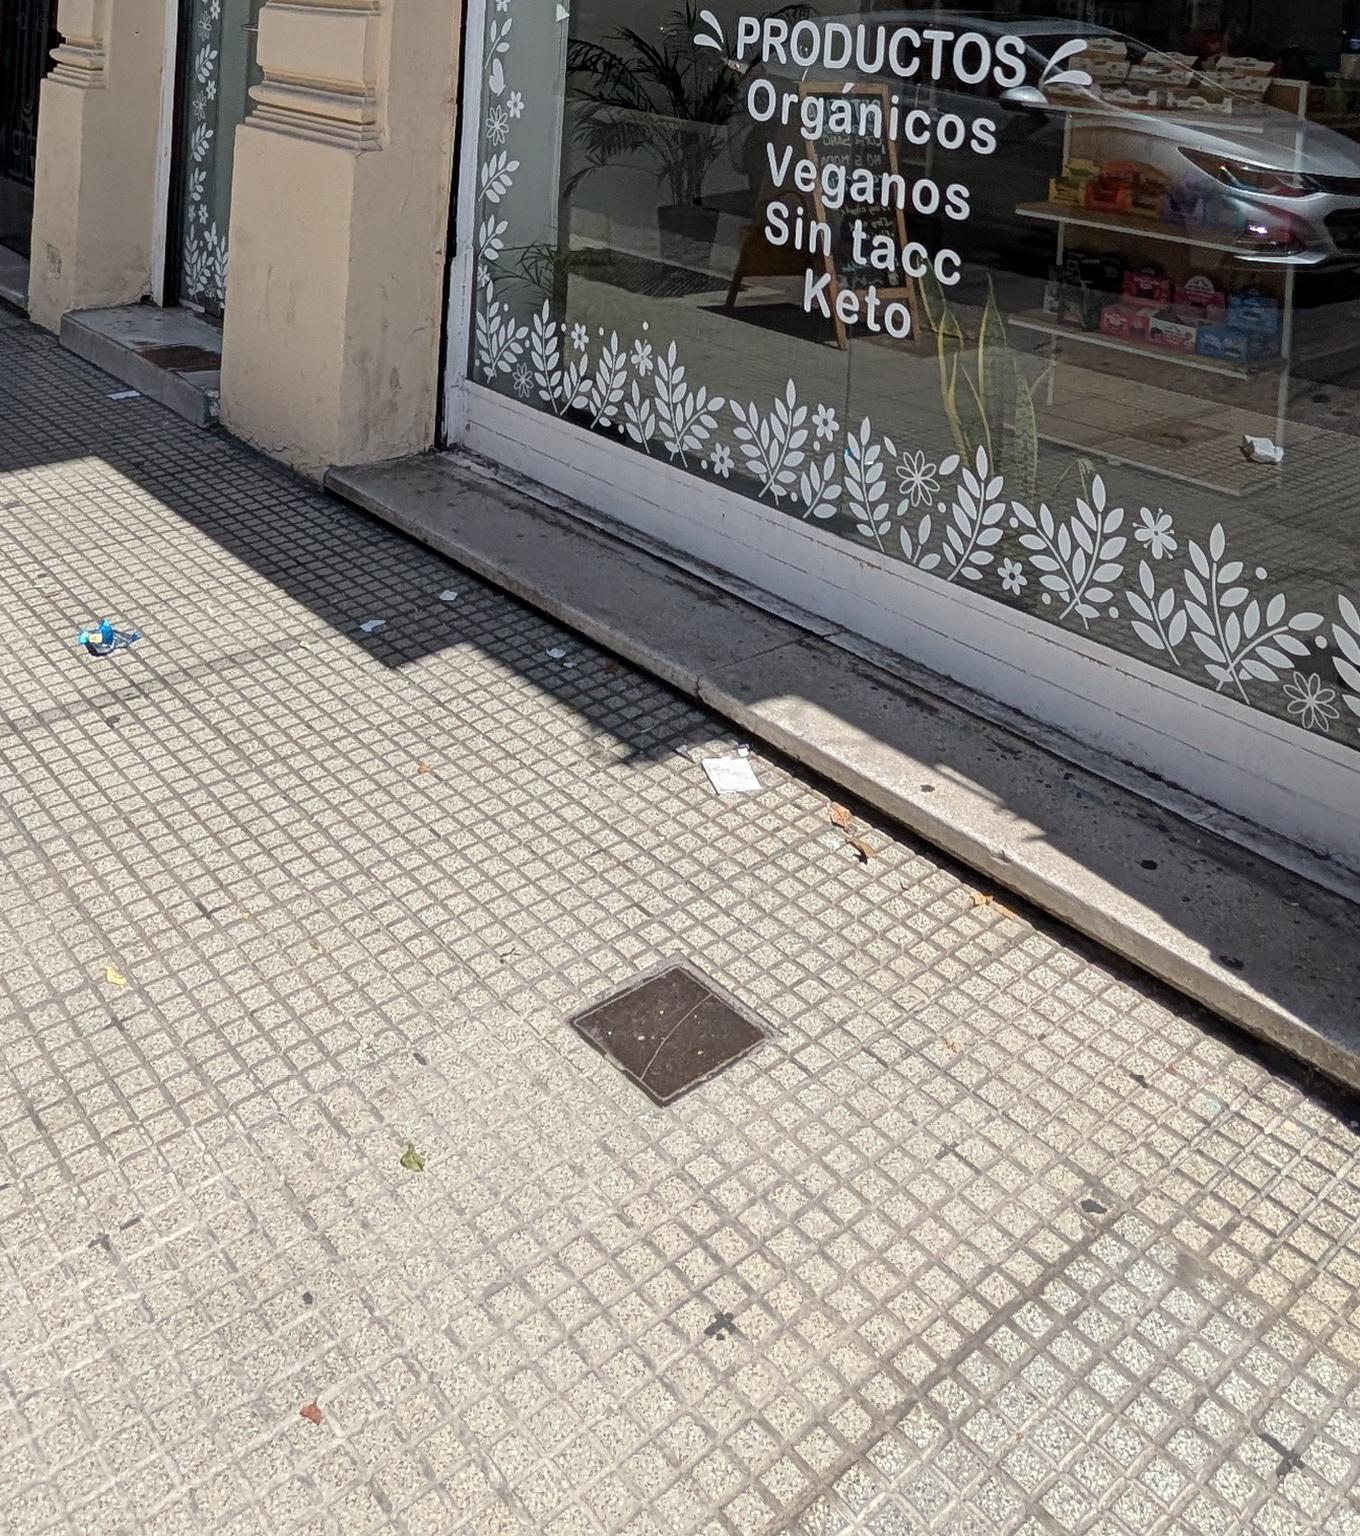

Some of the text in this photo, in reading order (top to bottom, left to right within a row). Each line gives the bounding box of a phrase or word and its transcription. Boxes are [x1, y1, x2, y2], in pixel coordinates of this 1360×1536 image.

[736, 16, 1026, 88] PRODUCTOS
[747, 78, 997, 156] Orgánicos
[766, 142, 971, 221] Veganos
[764, 201, 962, 287] Sin tacc
[803, 267, 911, 339] Keto
